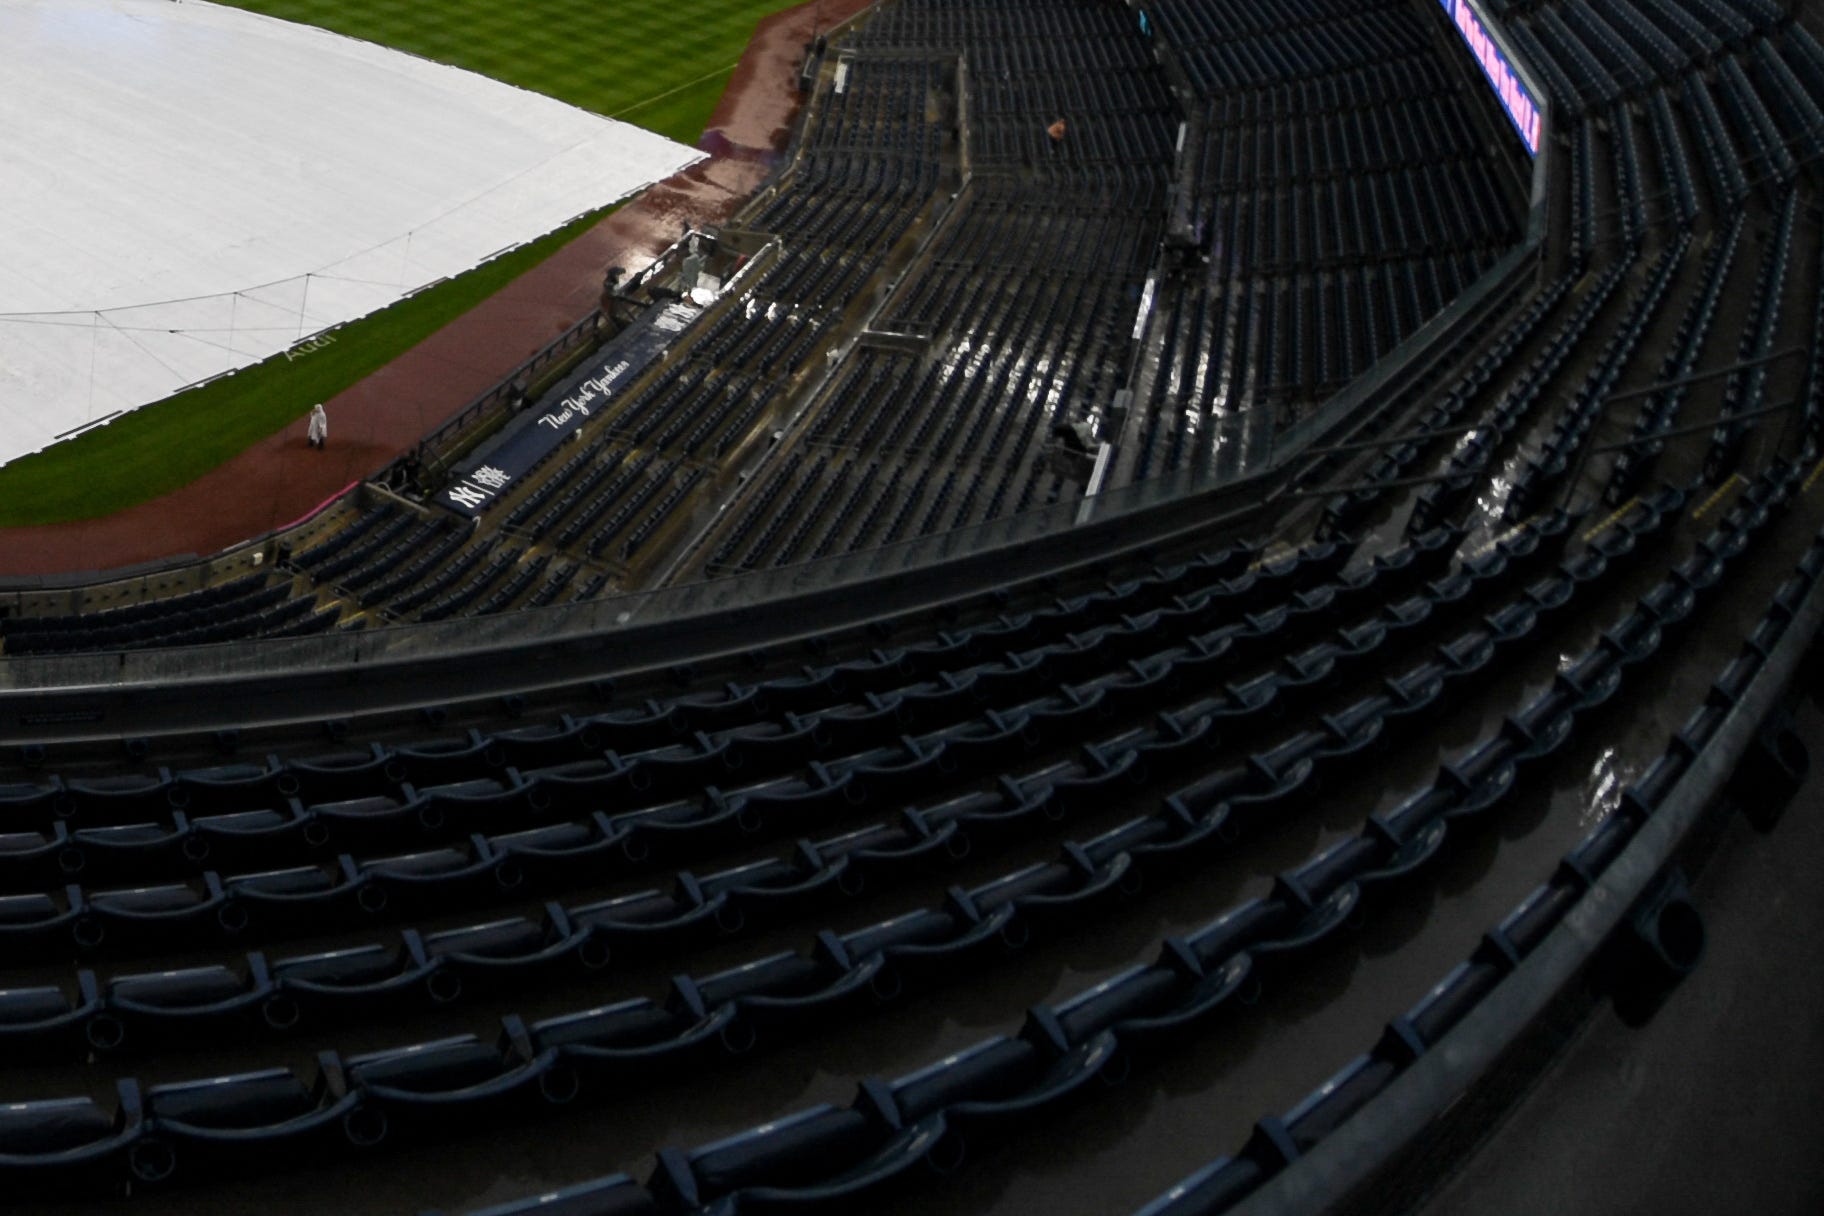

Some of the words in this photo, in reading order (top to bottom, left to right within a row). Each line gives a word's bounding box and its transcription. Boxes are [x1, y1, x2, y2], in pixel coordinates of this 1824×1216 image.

[538, 408, 574, 430] New
[562, 388, 596, 416] York
[590, 360, 630, 397] Yankees
